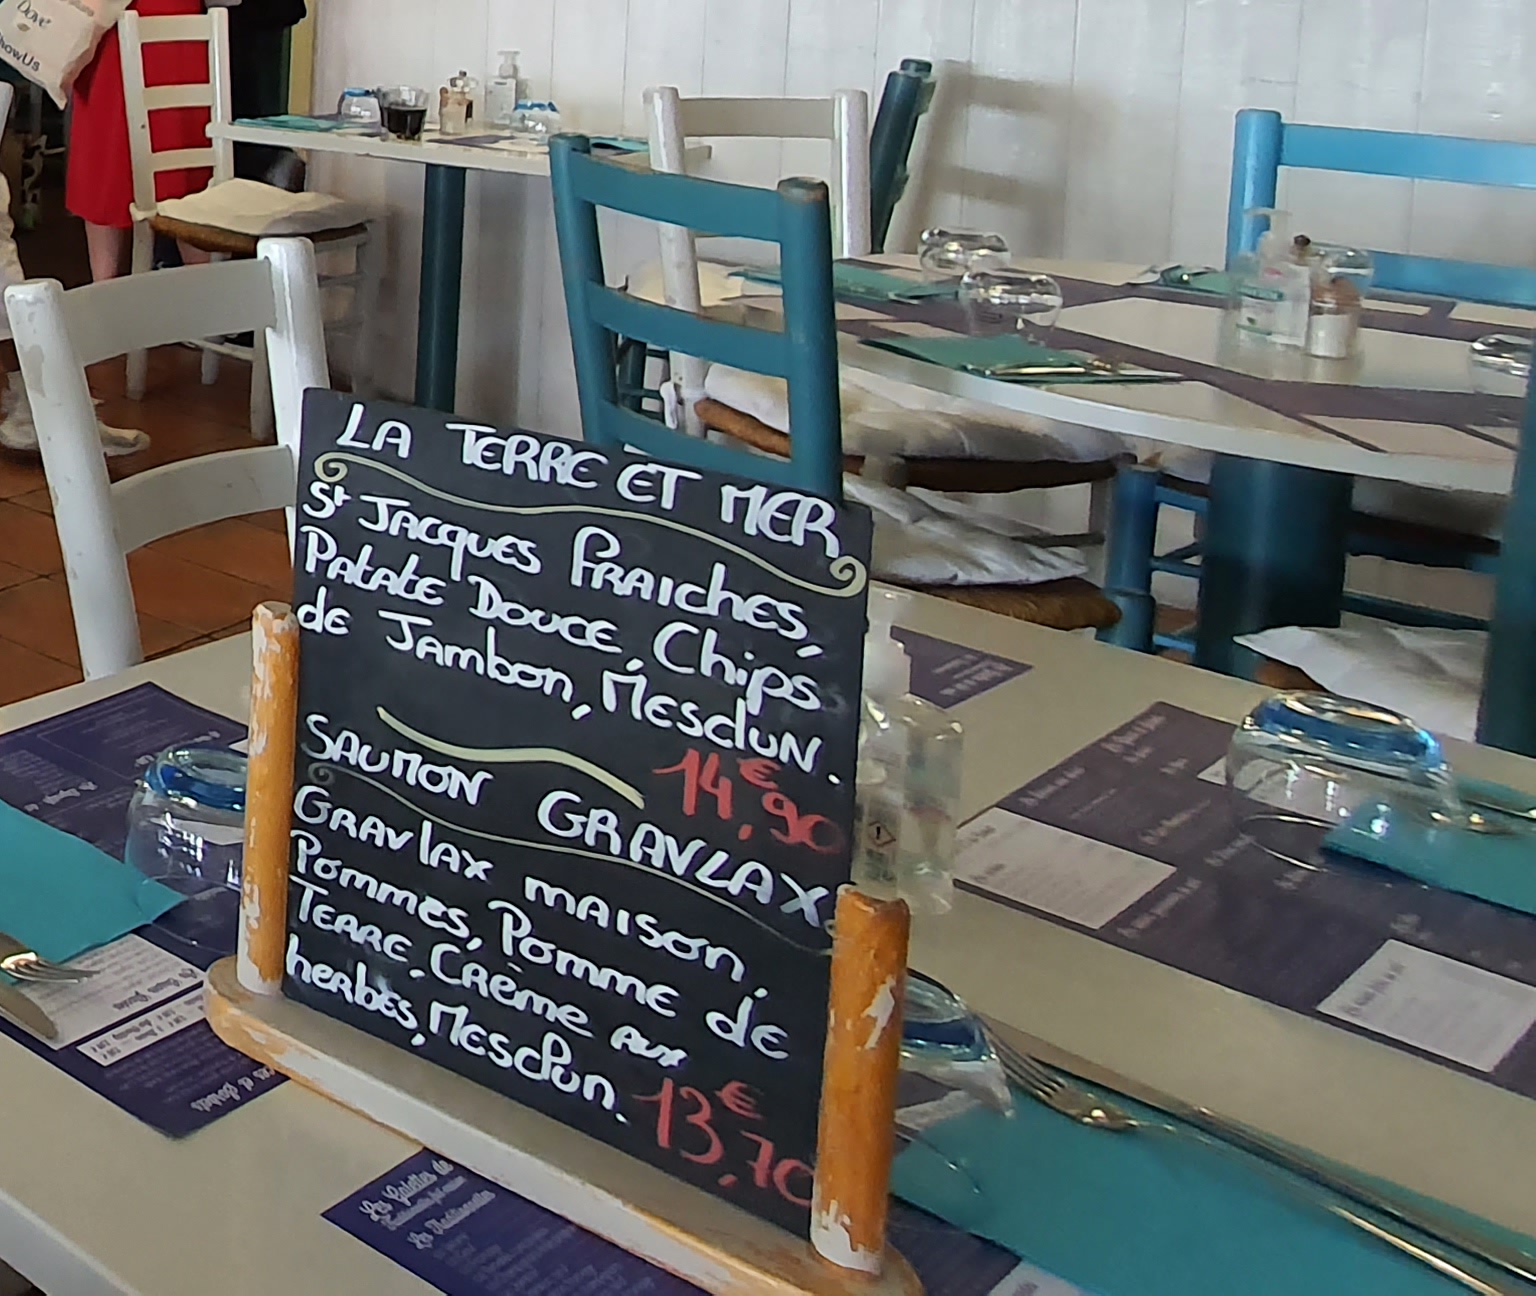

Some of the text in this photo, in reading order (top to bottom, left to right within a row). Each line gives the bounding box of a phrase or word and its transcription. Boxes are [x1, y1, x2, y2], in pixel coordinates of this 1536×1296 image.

[336, 404, 840, 558] LA TERRE ET MER
[652, 621, 822, 716] Chips
[301, 714, 829, 927] SAUMON GRAVLAX
[488, 900, 680, 1018] Pomme
[609, 1025, 688, 1068] aux
